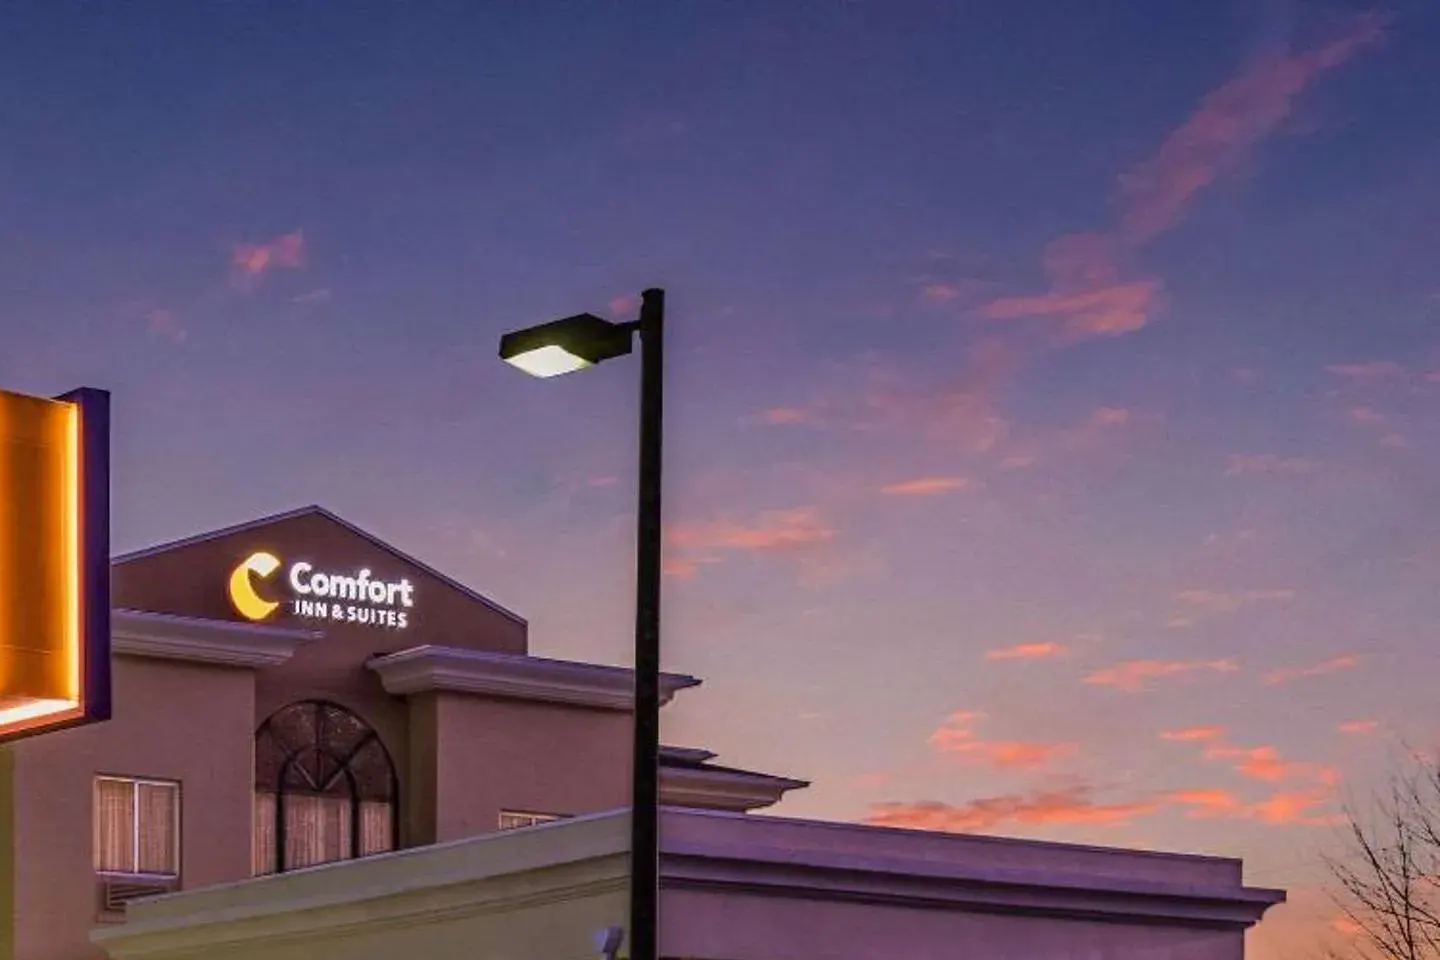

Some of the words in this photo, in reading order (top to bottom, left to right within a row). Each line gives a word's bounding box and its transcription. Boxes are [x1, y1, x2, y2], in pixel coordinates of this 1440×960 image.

[290, 562, 413, 607] Comfort
[295, 600, 327, 617] INN
[331, 604, 344, 620] &
[348, 607, 408, 628] SUITES
